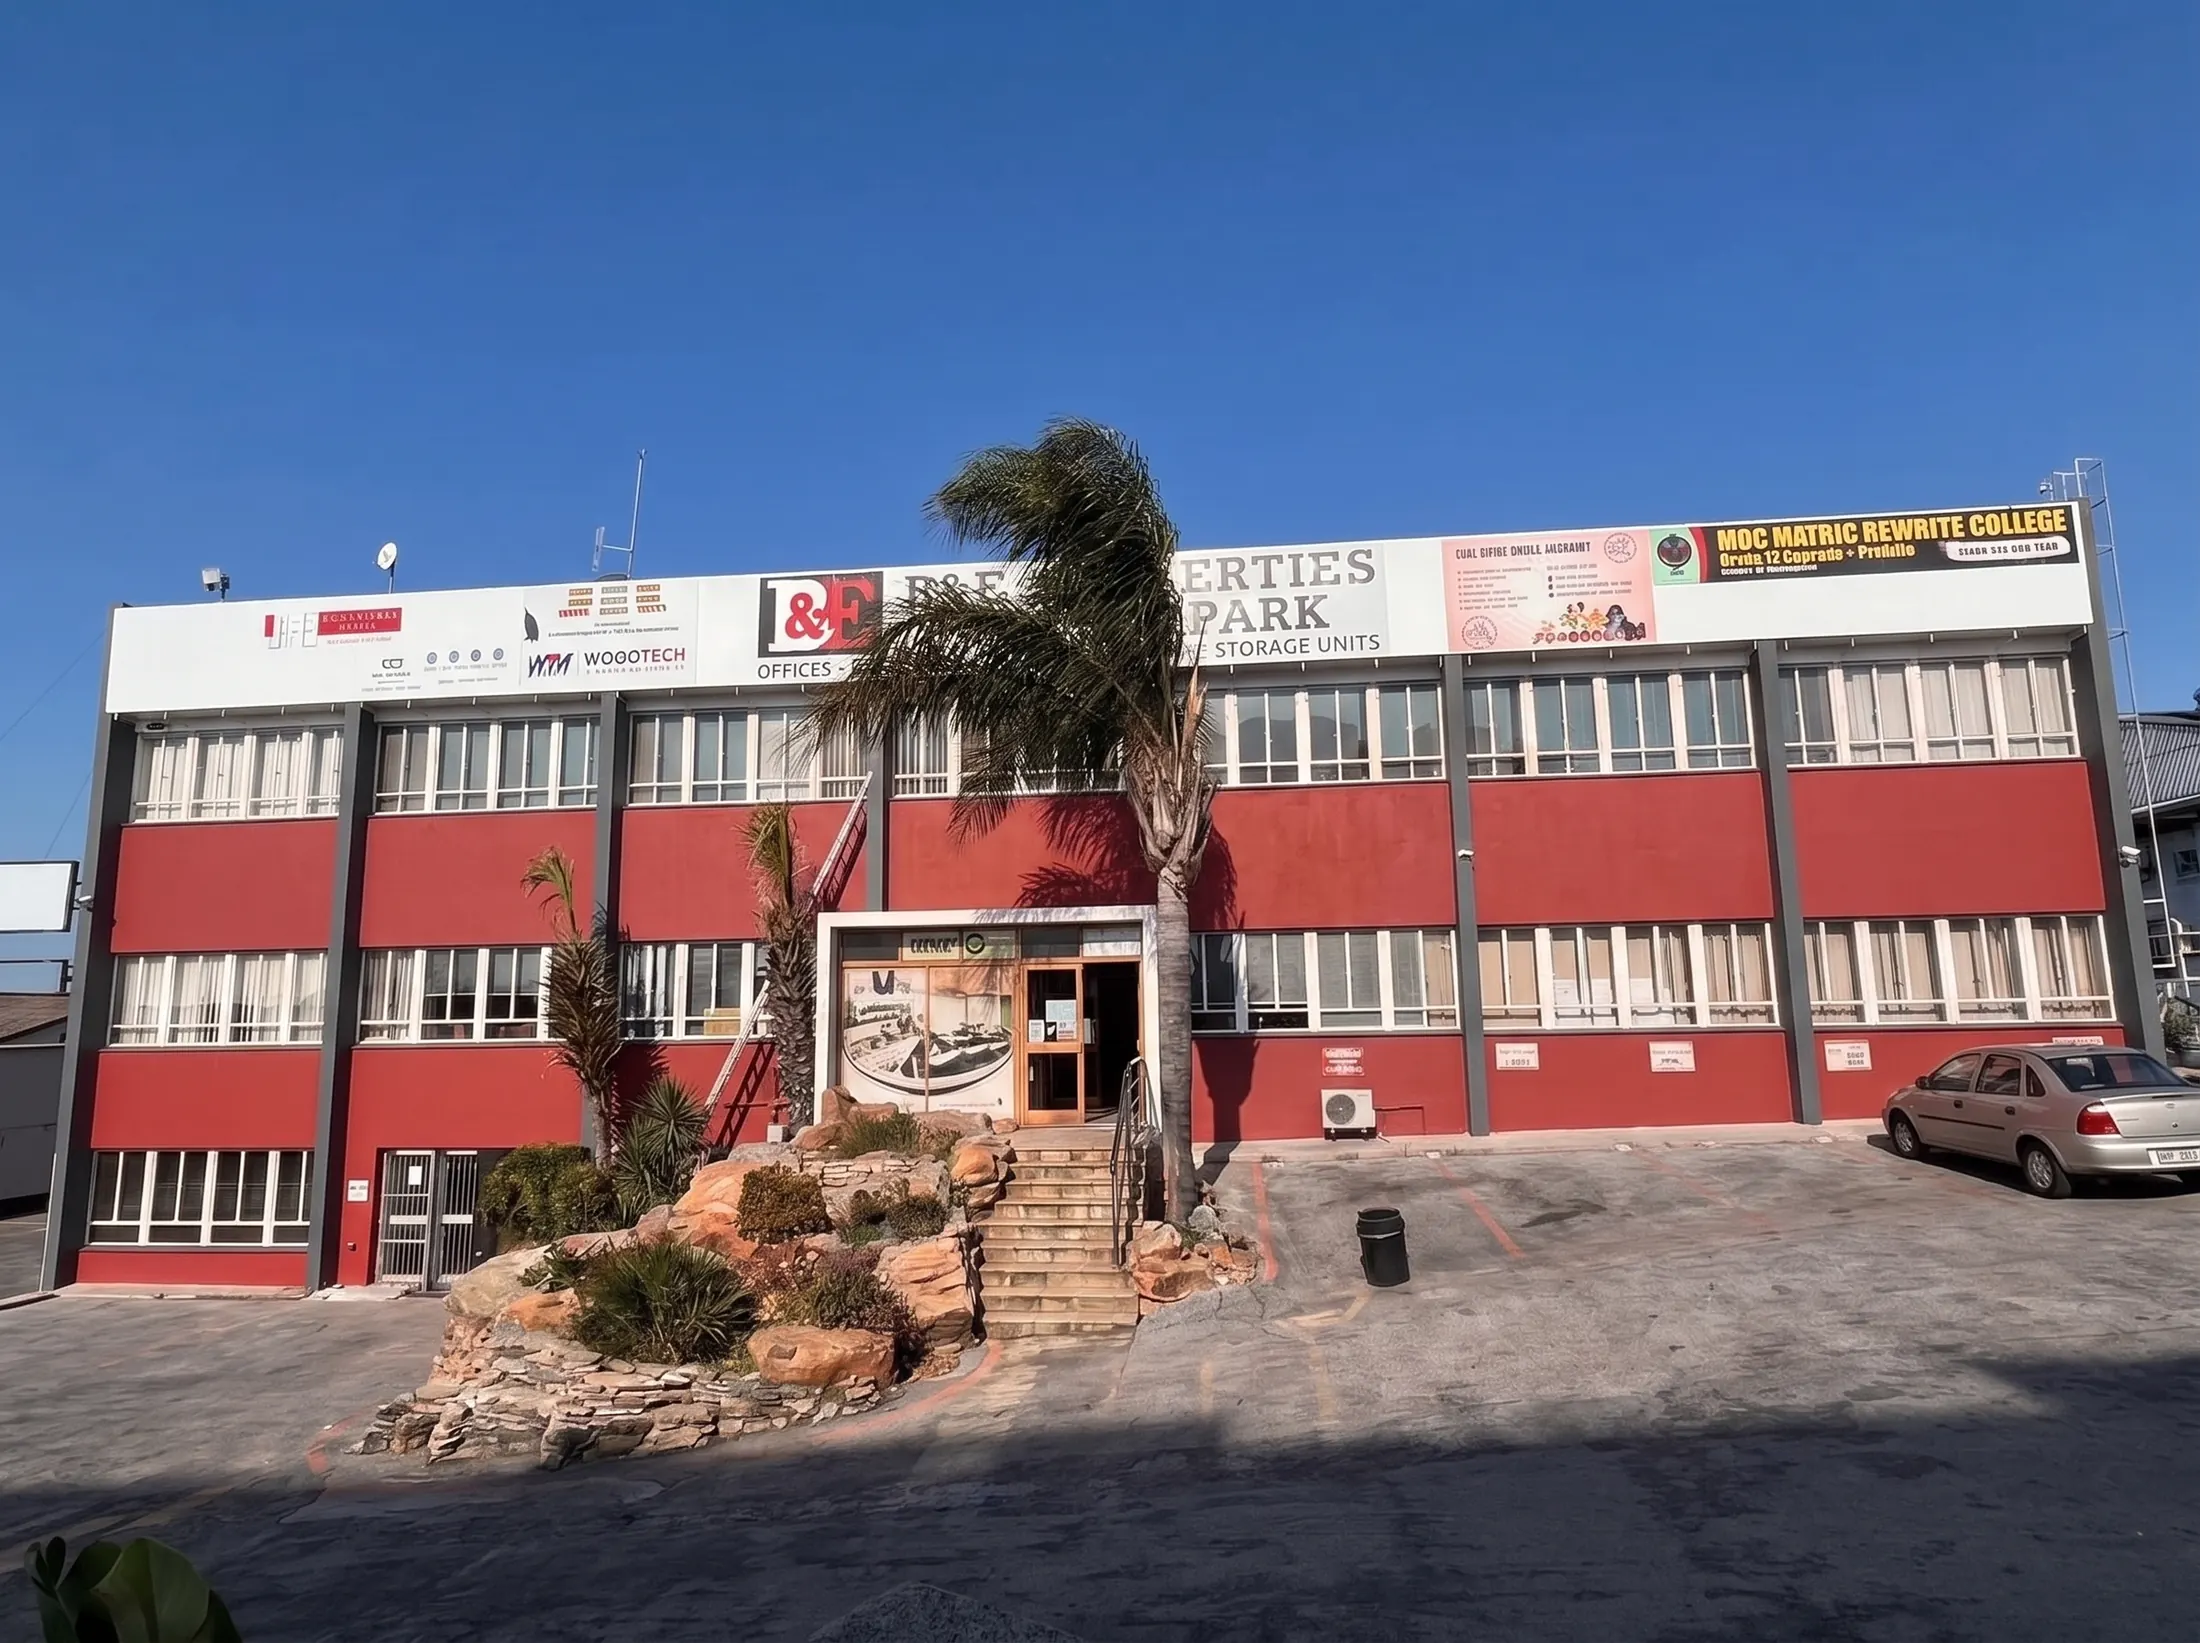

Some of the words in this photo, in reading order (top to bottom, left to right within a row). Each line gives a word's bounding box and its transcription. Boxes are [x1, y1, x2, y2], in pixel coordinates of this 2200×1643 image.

[1717, 528, 1768, 551] MOC
[1772, 522, 1858, 548] MATRIC
[1862, 516, 1965, 543] REWRITE
[1969, 509, 2067, 537] COLLEGE
[1180, 549, 1375, 593] ERTIES
[1763, 550, 1780, 564] 12
[1187, 594, 1330, 636] PARK
[1215, 637, 1310, 658] STORAGE
[1318, 634, 1380, 653] UNITS
[758, 661, 831, 679] OFFICES
